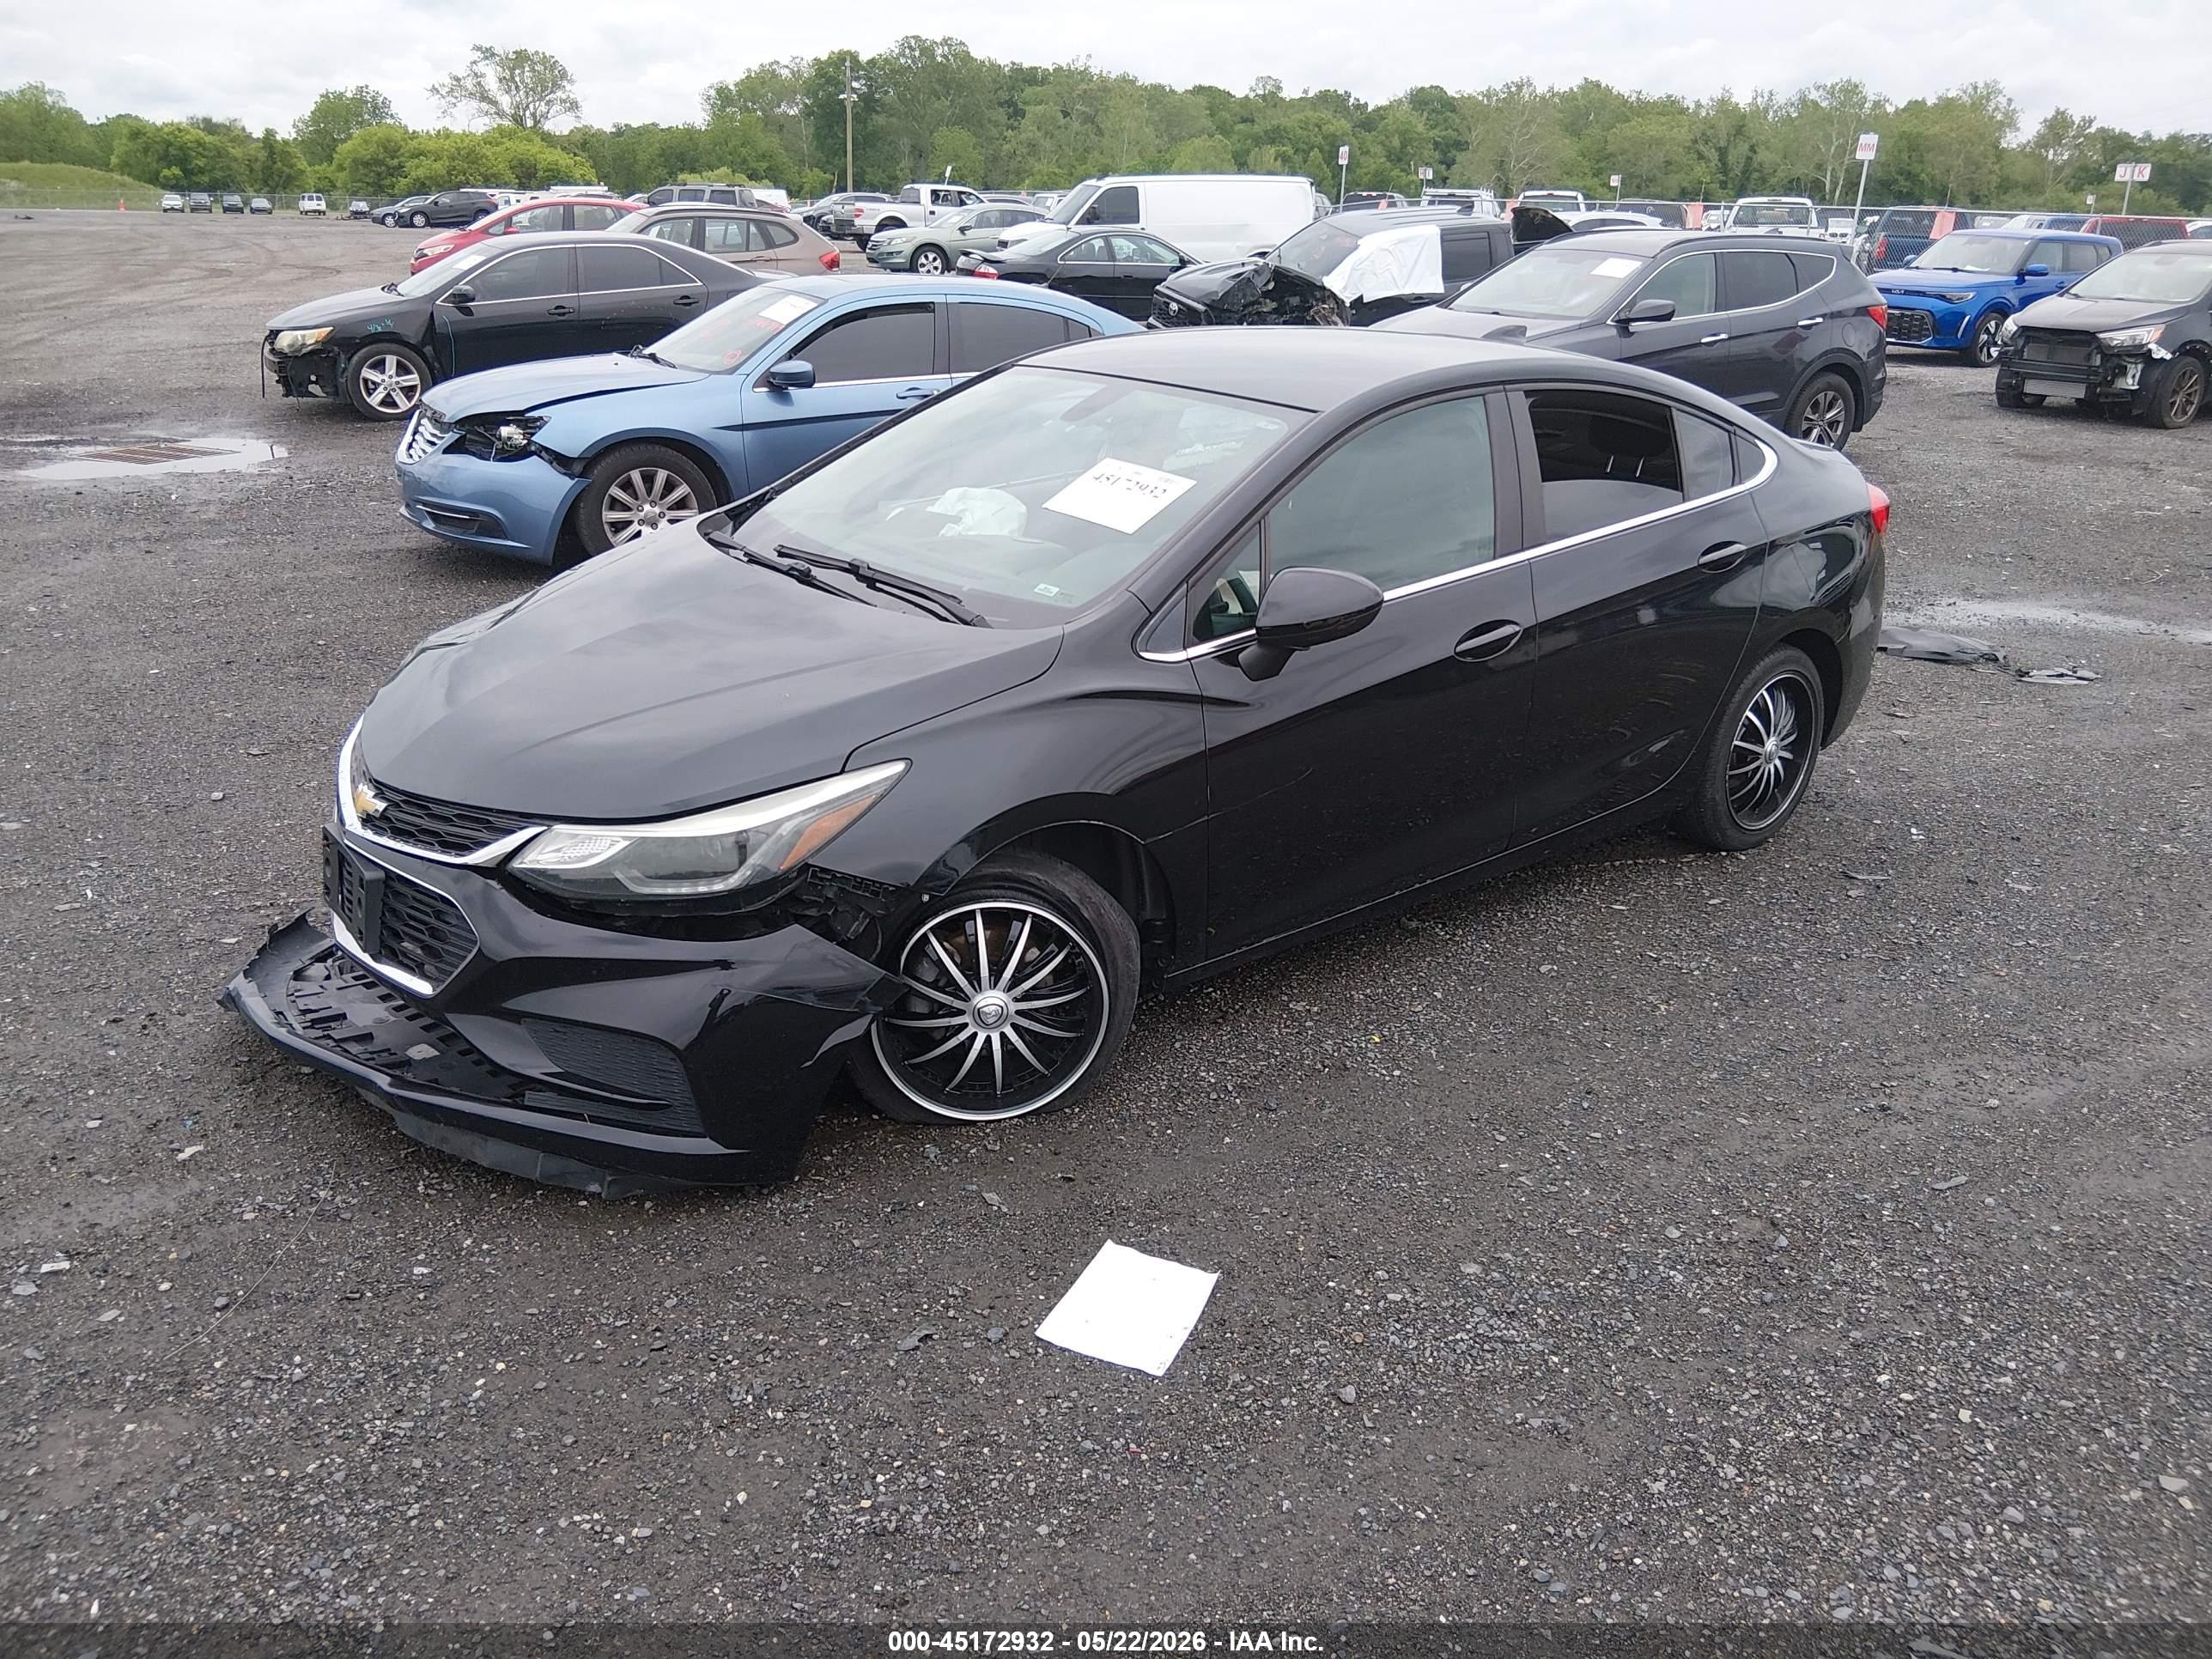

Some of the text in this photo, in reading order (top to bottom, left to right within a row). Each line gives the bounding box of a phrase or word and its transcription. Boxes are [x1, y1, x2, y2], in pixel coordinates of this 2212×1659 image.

[1858, 143, 1875, 152] MM
[1340, 150, 1347, 161] 40
[2118, 166, 2128, 179] J
[2136, 166, 2148, 179] K
